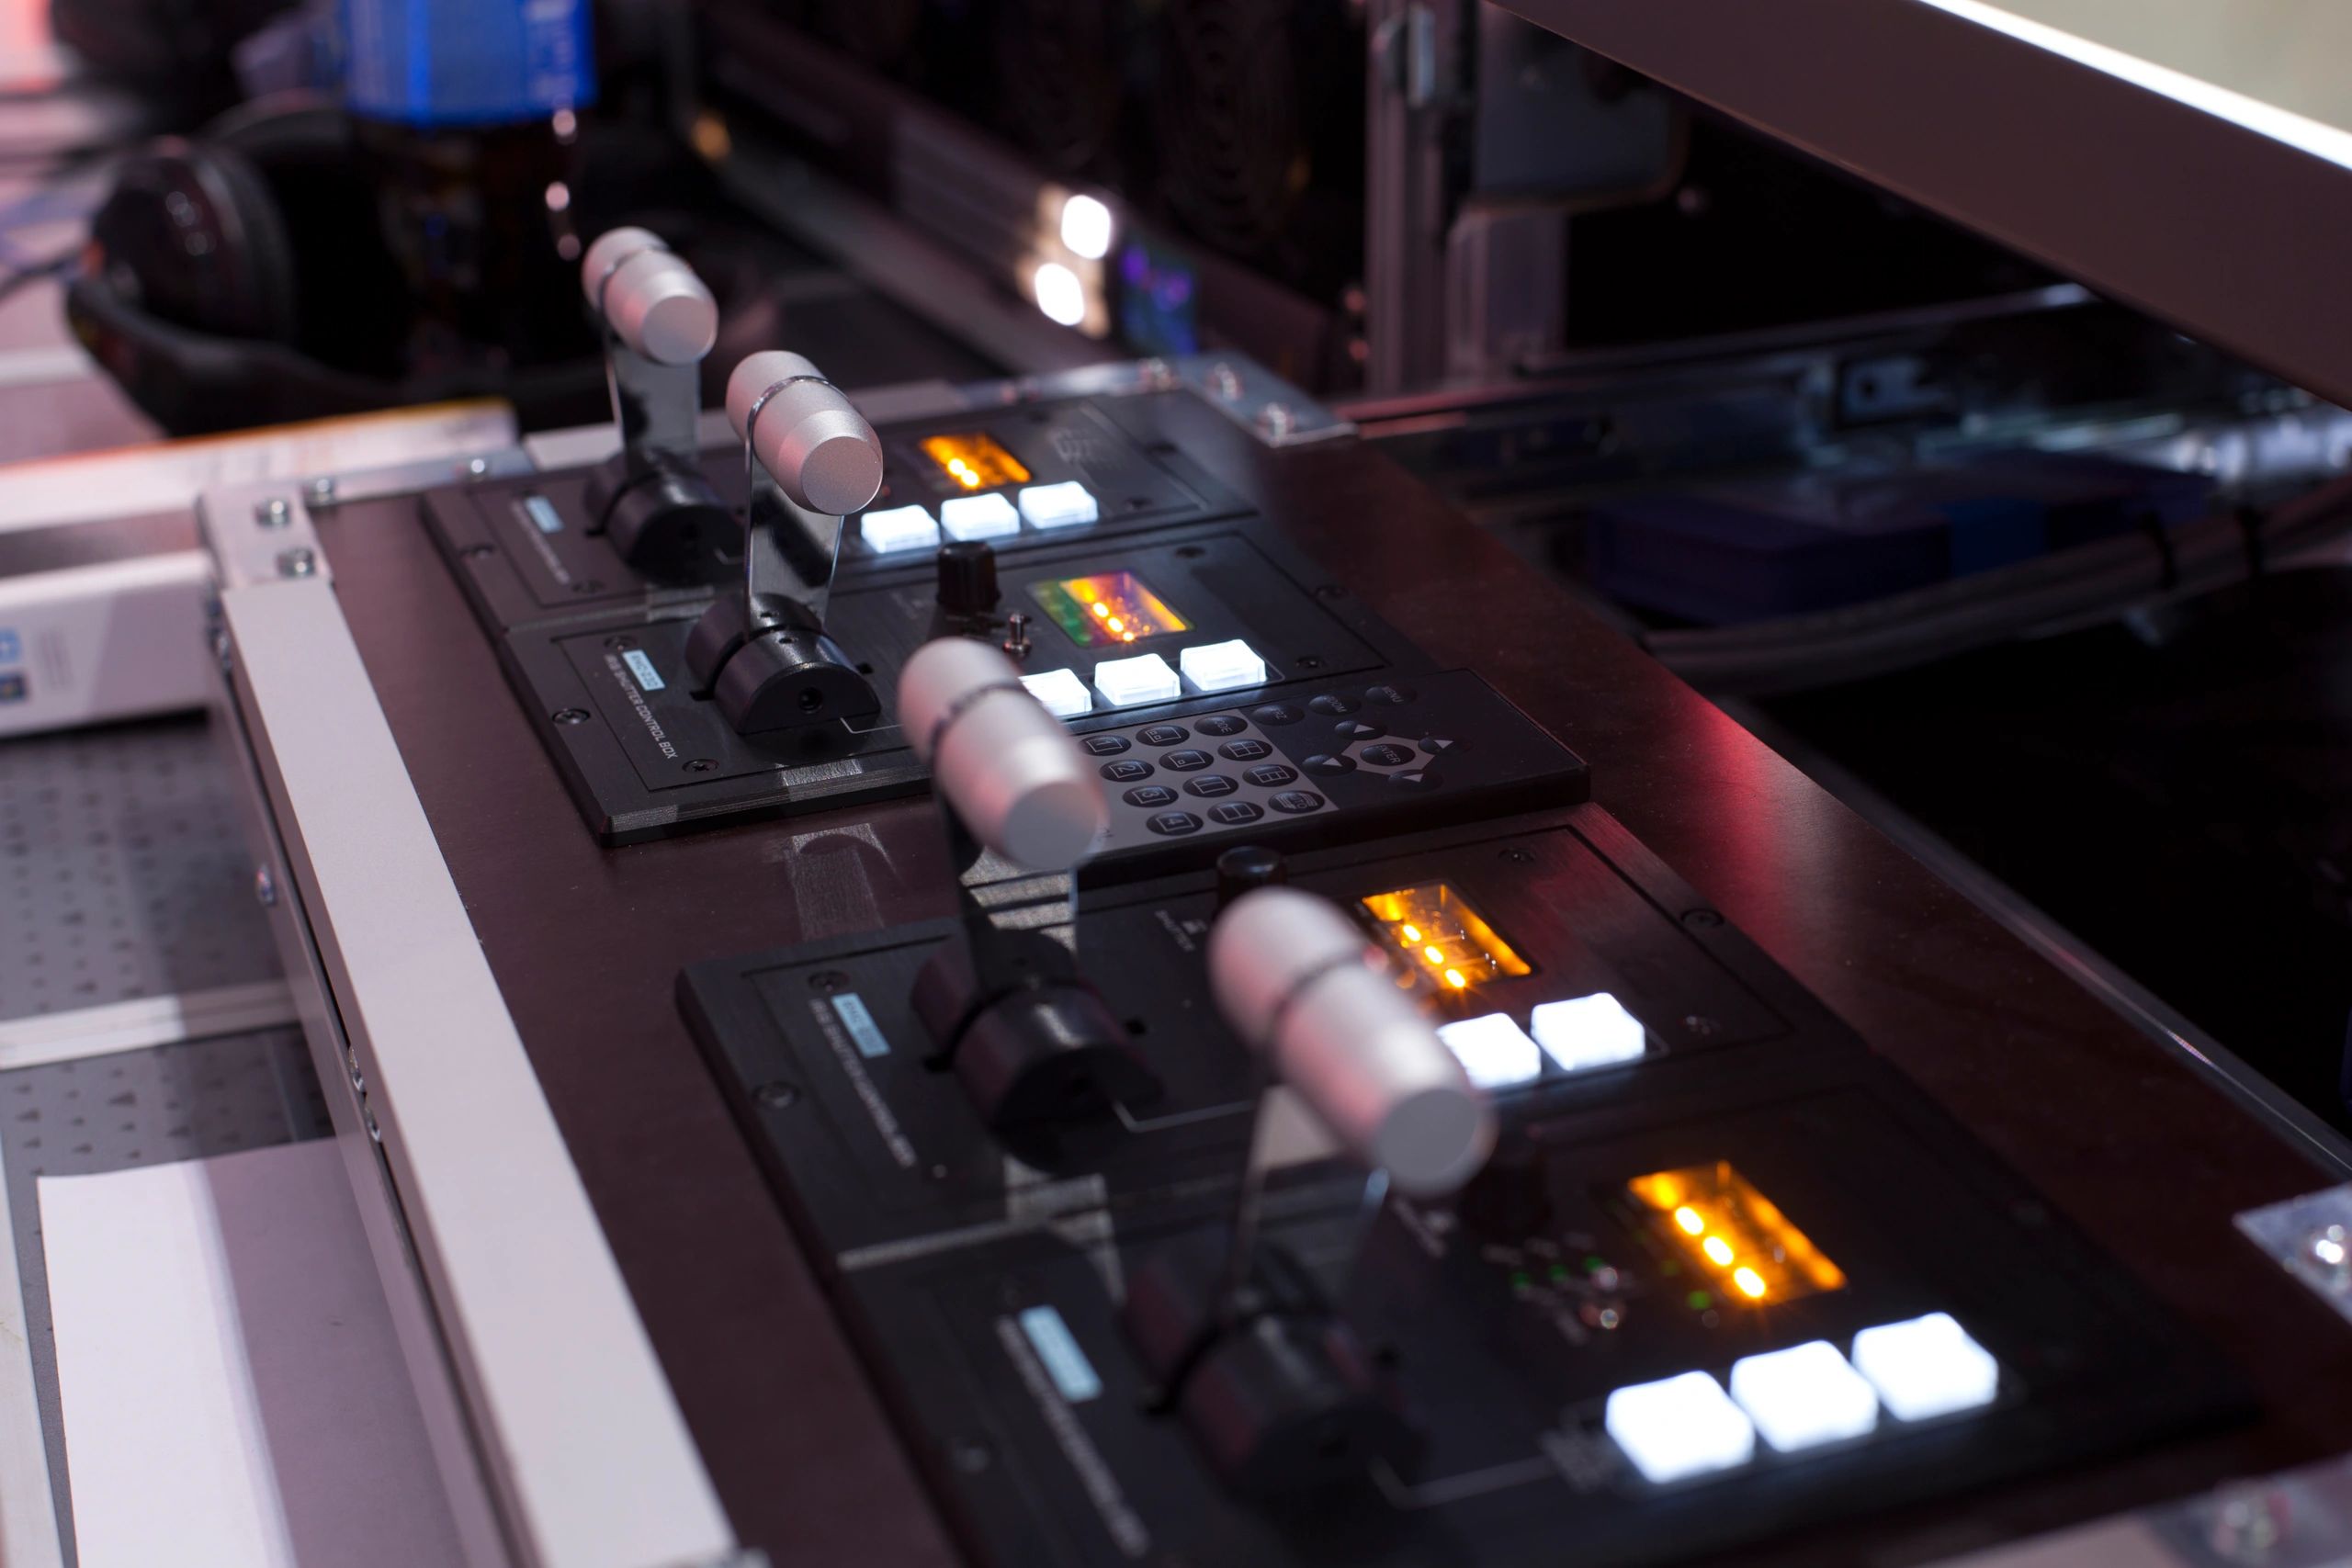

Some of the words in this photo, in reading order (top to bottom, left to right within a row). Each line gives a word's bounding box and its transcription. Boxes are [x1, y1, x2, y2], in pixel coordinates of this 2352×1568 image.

[636, 705, 666, 741] CONTROL
[658, 741, 678, 759] BOX
[1376, 744, 1402, 764] ENTER
[1117, 764, 1136, 773] 2
[1141, 790, 1159, 798] 3
[1167, 818, 1184, 826] 4
